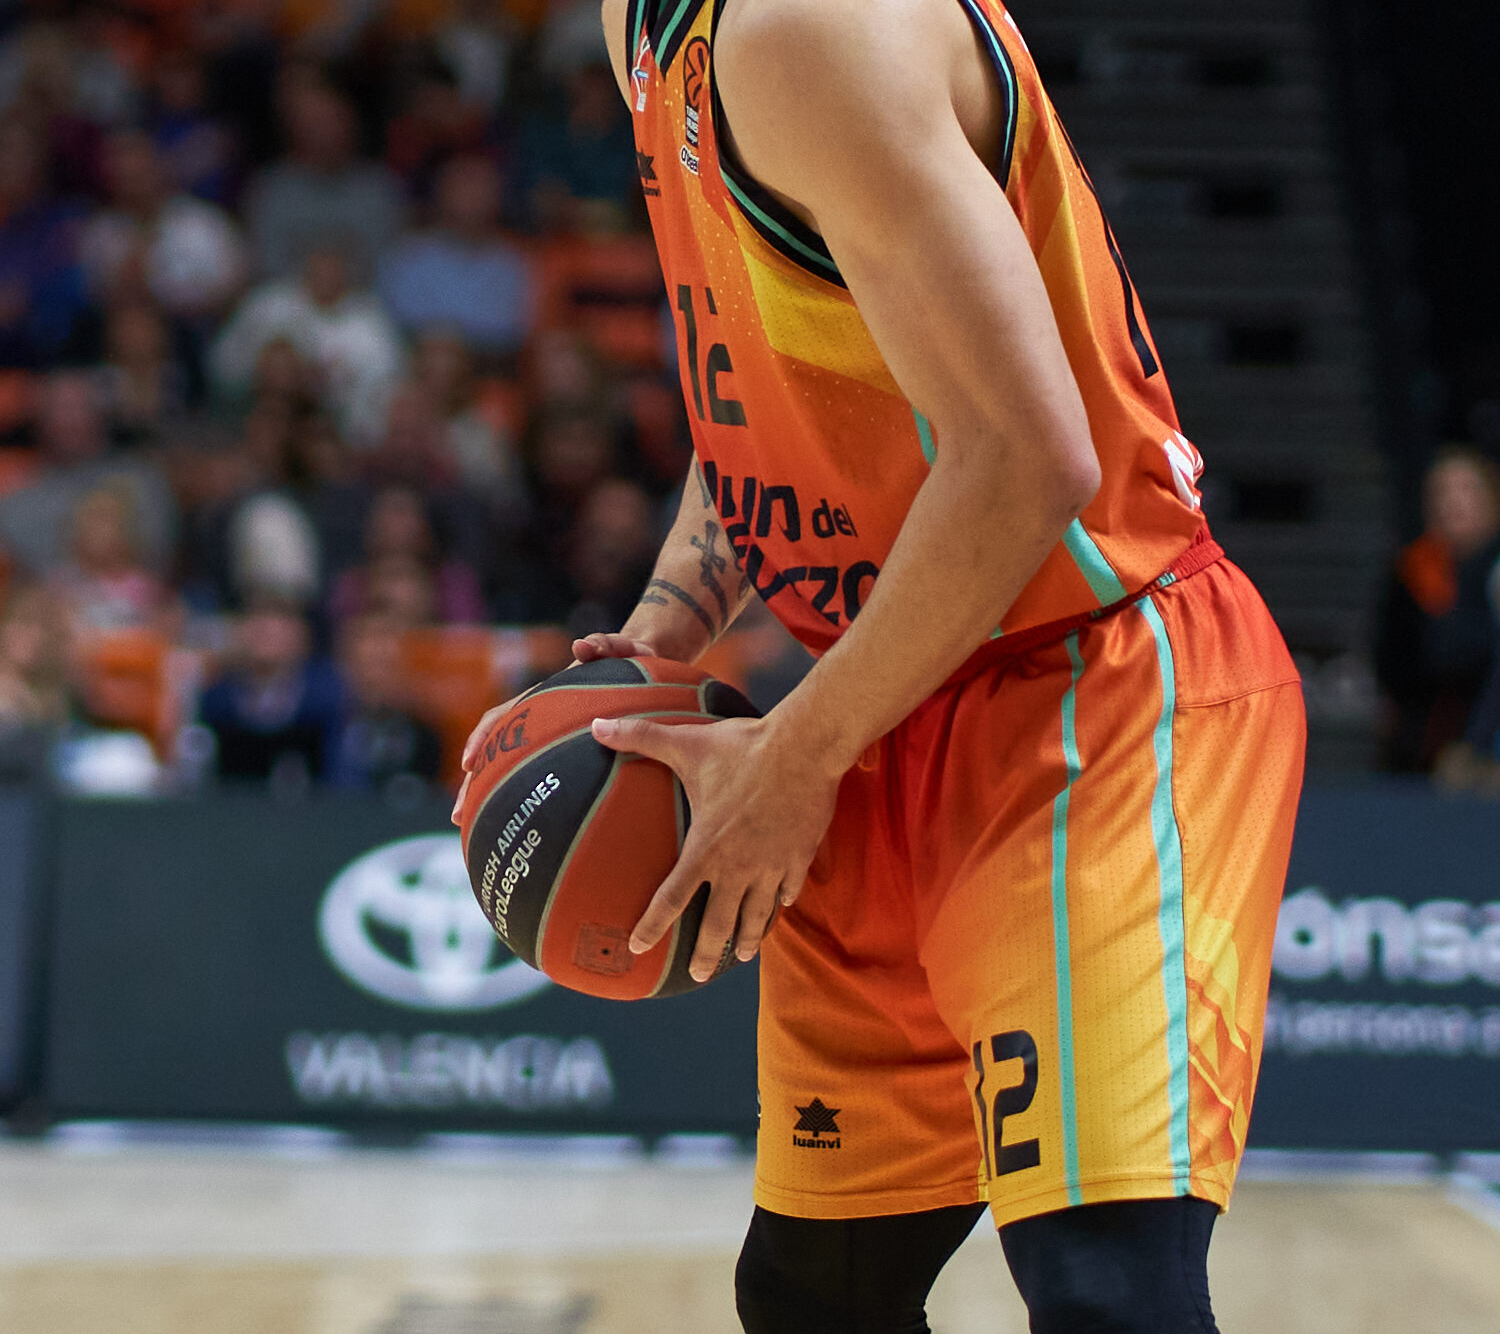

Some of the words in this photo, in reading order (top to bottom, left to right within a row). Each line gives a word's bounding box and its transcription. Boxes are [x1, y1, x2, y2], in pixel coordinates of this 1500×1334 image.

[677, 283, 749, 429] 12
[496, 772, 561, 857] AIRLINES
[284, 1031, 614, 1109] VALENCIA
[793, 1134, 842, 1149] luanvi
